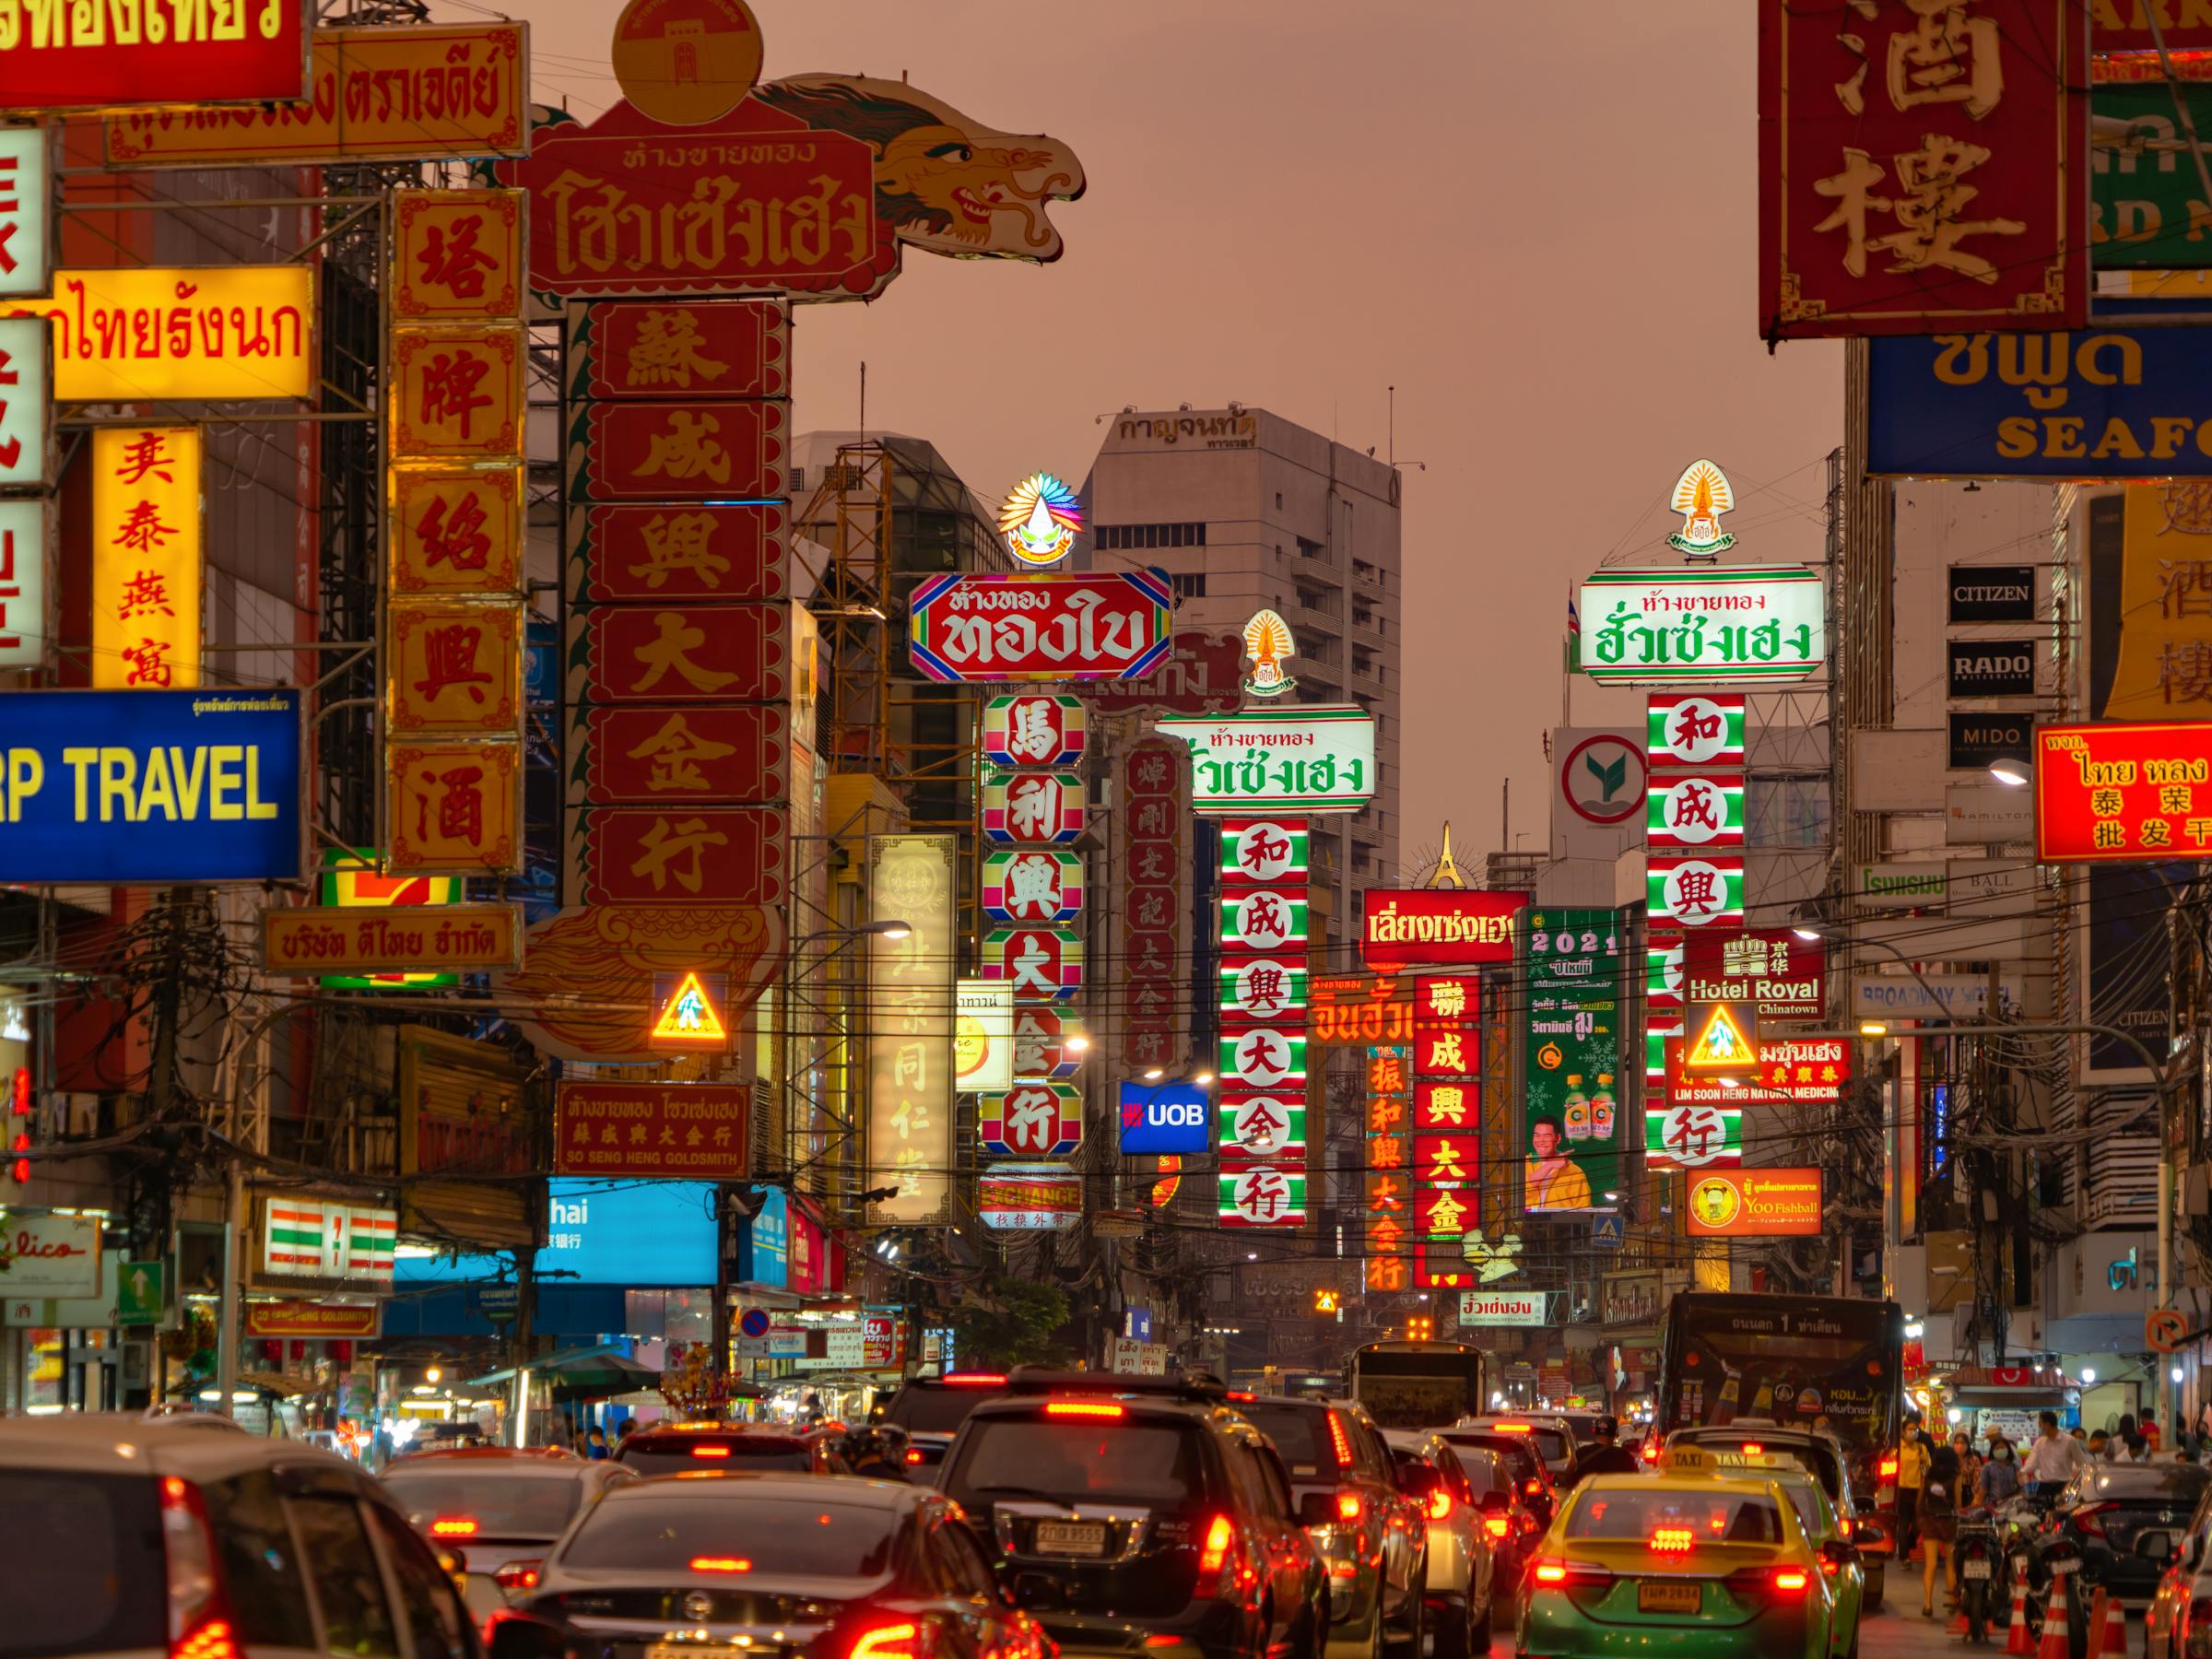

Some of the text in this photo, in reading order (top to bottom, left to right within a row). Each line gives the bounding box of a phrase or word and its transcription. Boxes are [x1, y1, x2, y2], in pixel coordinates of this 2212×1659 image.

[949, 584, 1051, 609] ห้างทอง
[1641, 590, 1765, 612] ห้างขายทอง
[1953, 585, 2030, 603] CITIZEN
[941, 588, 1146, 663] ทองใบ
[1953, 656, 2030, 675] RADO
[1210, 726, 1314, 747] ห้างขายทอง
[1963, 729, 2020, 745] MIDO
[2073, 751, 2207, 785] ไทย หลง
[63, 744, 280, 822] TRAVEL
[1971, 877, 2014, 889] BALL
[281, 924, 347, 959] บริษัท
[434, 922, 496, 956] จำกัด
[1531, 932, 1618, 957] 2021
[1690, 978, 1818, 1000] Hotel Royal
[1758, 1004, 1818, 1015] Chinatown
[2118, 1010, 2169, 1027] CITIZEN
[1675, 1089, 1692, 1100] LIM
[1693, 1088, 1721, 1100] SOON
[1722, 1088, 1749, 1100] HENG
[1794, 1087, 1840, 1099] MEDICIN
[1147, 1103, 1205, 1126] UOB
[1428, 982, 1468, 1286] 聯成興大金
[566, 1149, 738, 1166] SO SENG HENG GOLDSMITH
[980, 1185, 1079, 1206] EXCHANGE
[549, 1198, 589, 1226] hai
[1775, 1201, 1818, 1214] Fishball
[1782, 1313, 1790, 1333] 1
[1674, 1453, 1702, 1467] TAXI
[1719, 1453, 1747, 1466] TAXI
